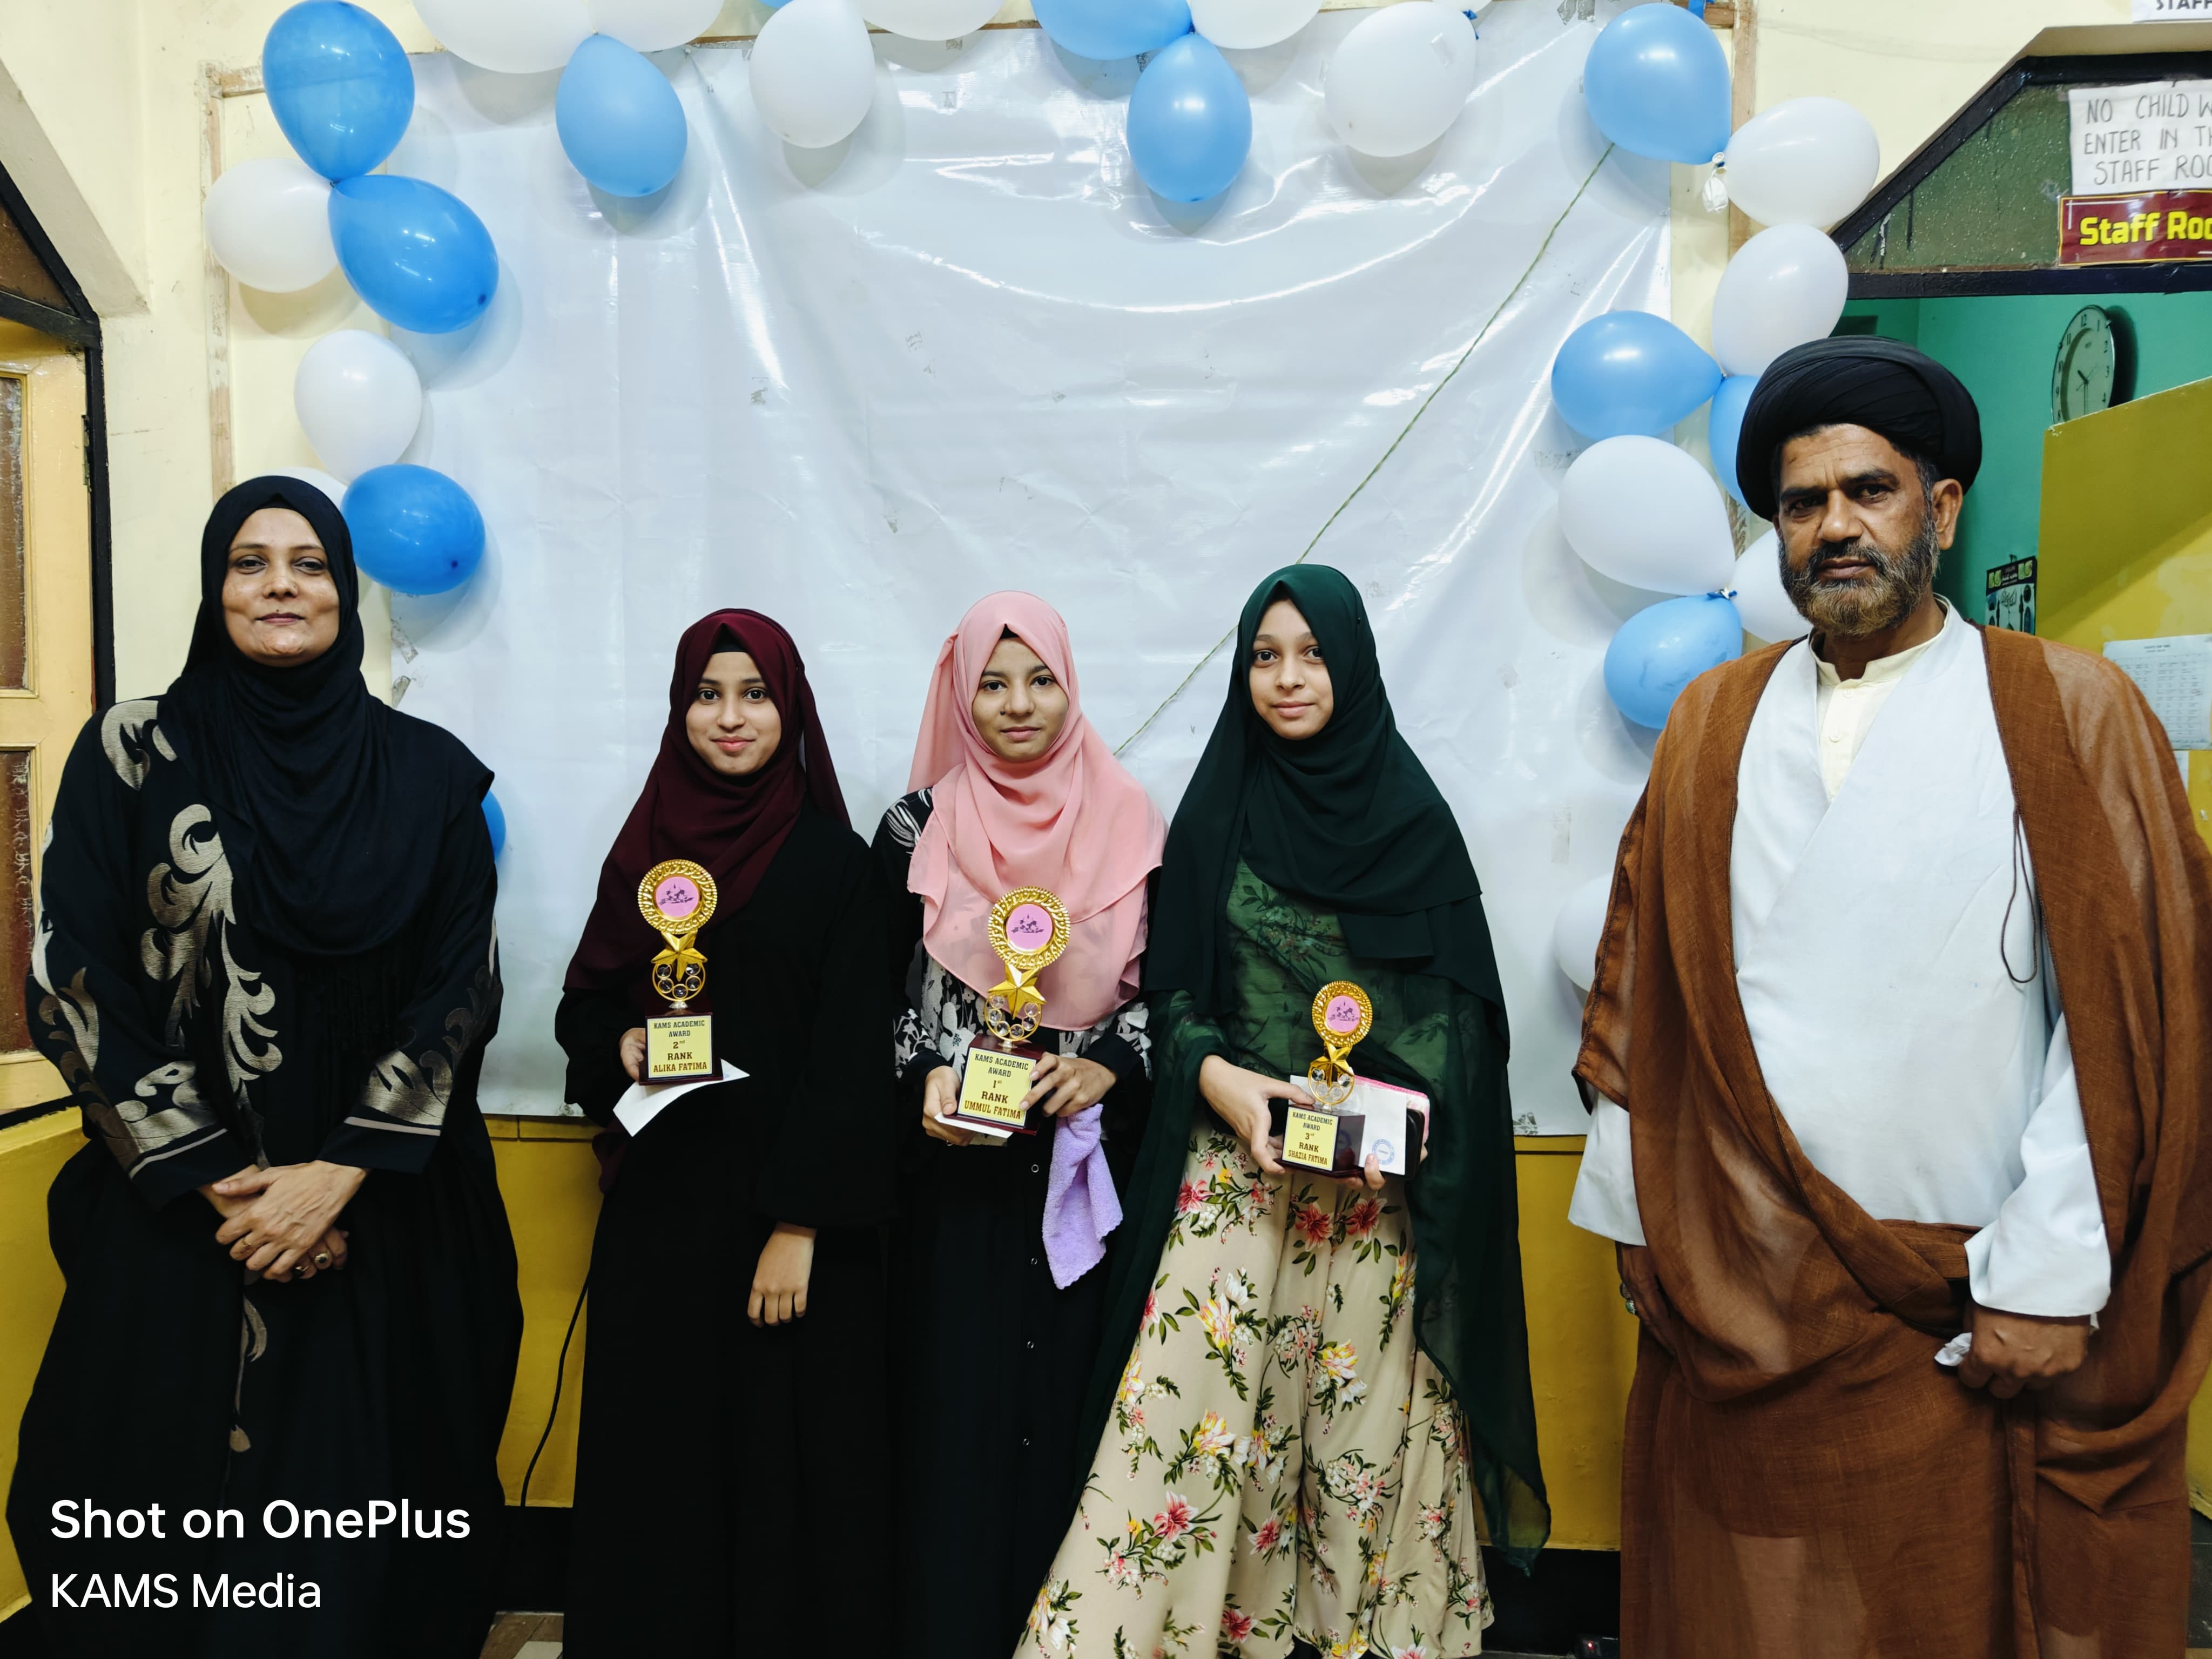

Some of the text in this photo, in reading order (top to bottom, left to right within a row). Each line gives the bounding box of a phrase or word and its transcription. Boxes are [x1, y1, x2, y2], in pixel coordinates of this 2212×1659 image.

[2087, 99, 2113, 124] NO
[2136, 93, 2189, 119] CHILD
[2084, 130, 2141, 154] ENTER
[2160, 128, 2177, 150] IN
[2094, 158, 2160, 185] STAFF
[2080, 212, 2161, 245] Staff
[2081, 314, 2087, 327] 12
[2103, 340, 2108, 353] 2
[667, 1052, 692, 1061] RANK
[974, 1054, 1029, 1070] KAMS ACADEMIC
[653, 1062, 707, 1073] ALIKA FATIMA
[988, 1067, 1011, 1077] AWARD
[981, 1091, 1008, 1103] RANK
[965, 1100, 1021, 1120] UMMUL FATIMA
[1292, 1111, 1333, 1125] KAMS ACADEMIC
[1303, 1122, 1320, 1131] AWARD
[1299, 1142, 1319, 1152] RANK
[1288, 1149, 1327, 1165] SHAZIA FATIMA
